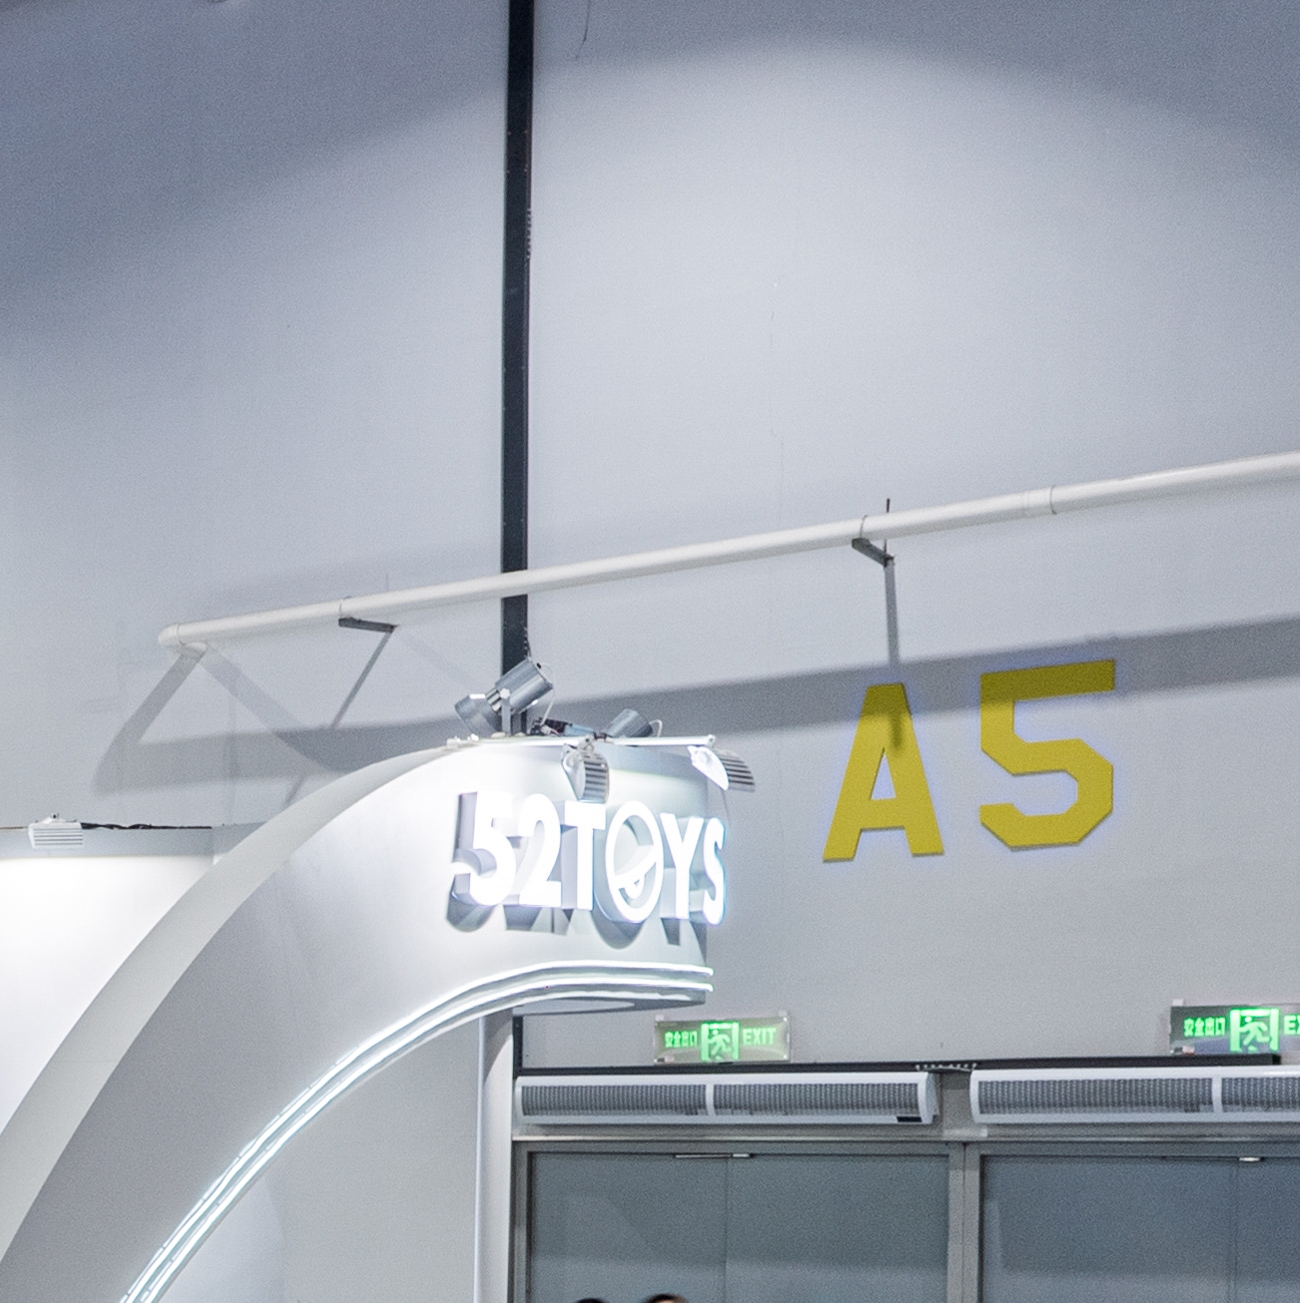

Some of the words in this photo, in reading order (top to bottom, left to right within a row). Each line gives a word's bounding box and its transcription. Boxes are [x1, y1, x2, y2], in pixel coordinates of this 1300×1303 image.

[821, 658, 1116, 864] A5
[450, 790, 727, 927] 52TOYS
[742, 1026, 777, 1045] EXIT
